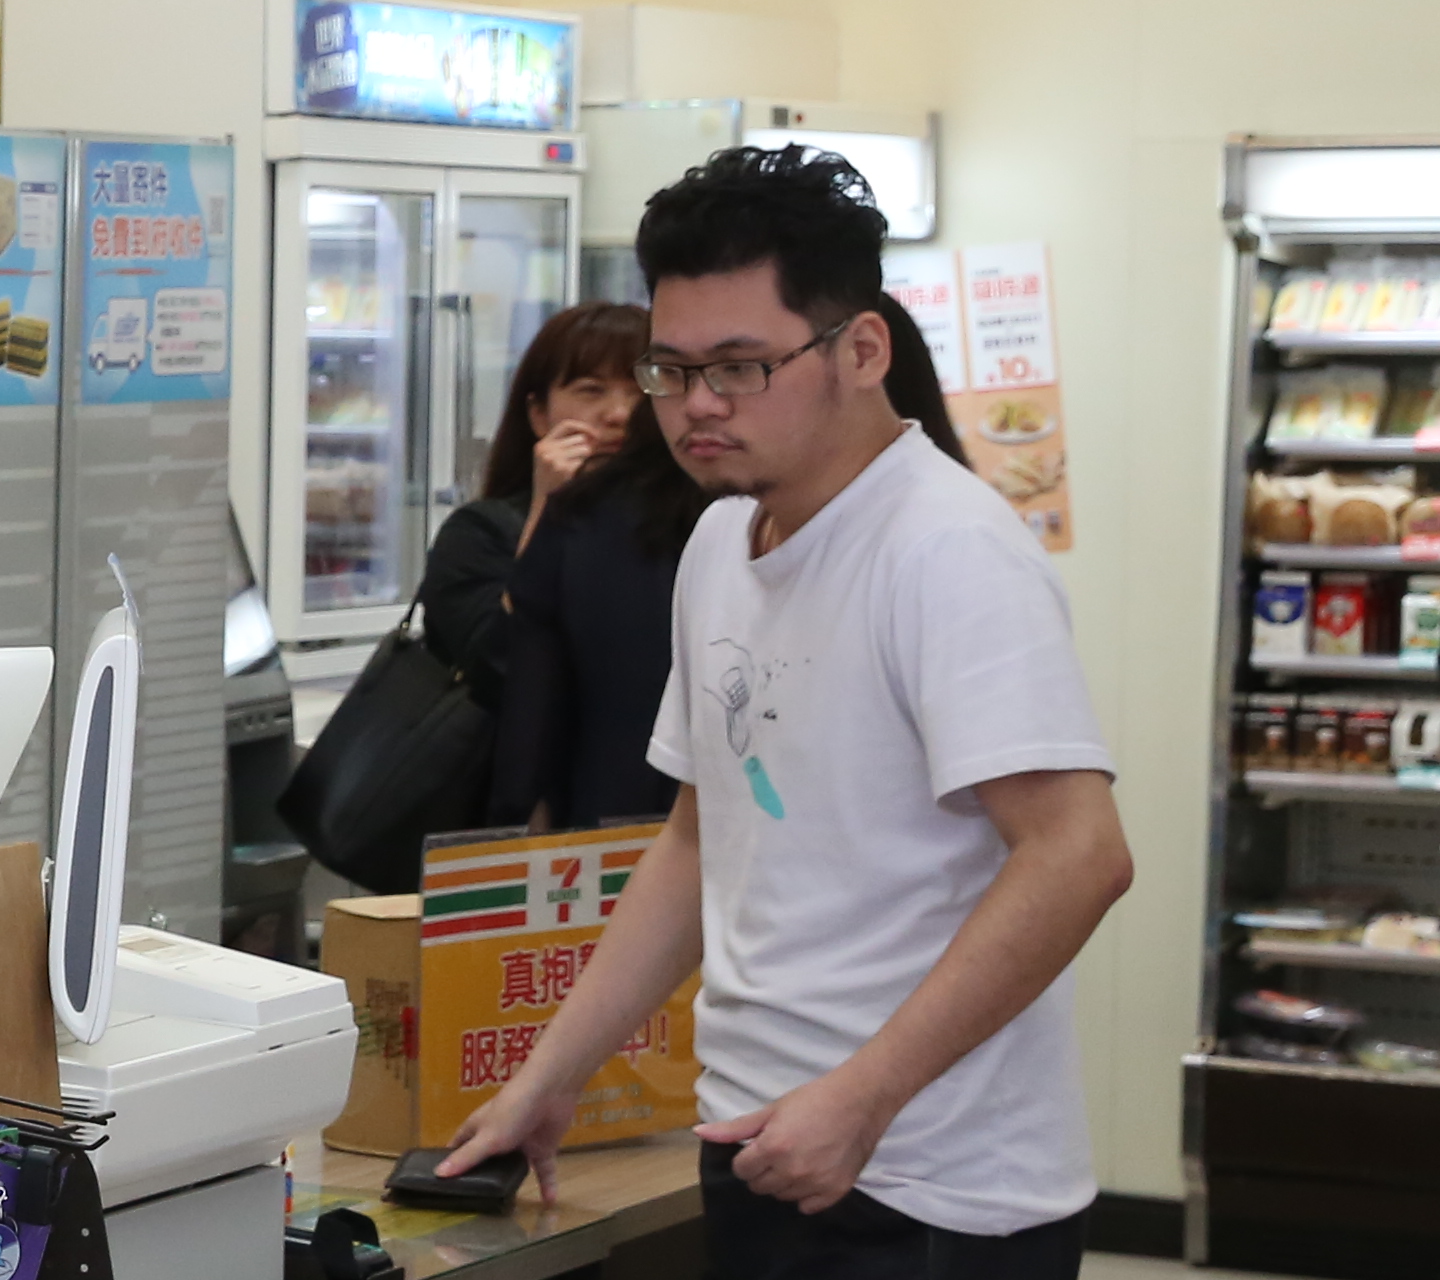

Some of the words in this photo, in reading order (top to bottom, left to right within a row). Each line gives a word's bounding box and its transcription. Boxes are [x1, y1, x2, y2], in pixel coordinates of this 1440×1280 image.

[92, 162, 168, 208] 大量寄件
[91, 215, 204, 260] 免費到府收件
